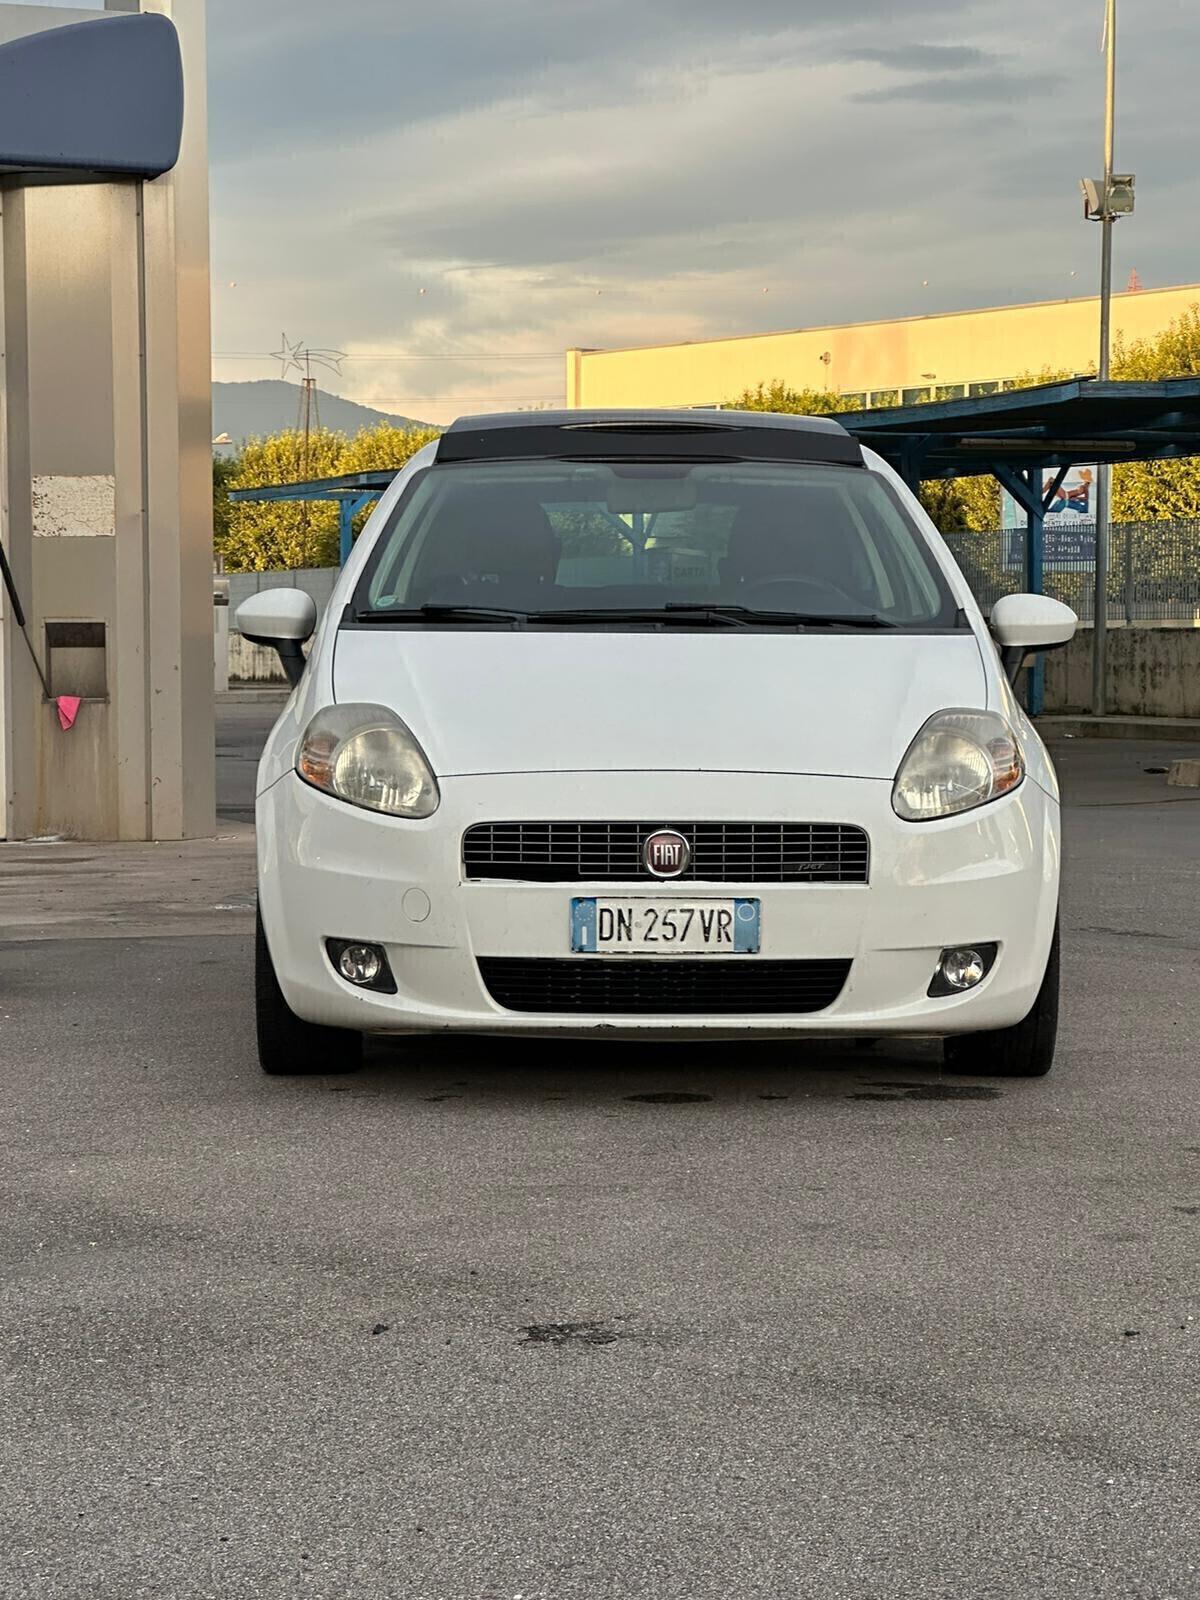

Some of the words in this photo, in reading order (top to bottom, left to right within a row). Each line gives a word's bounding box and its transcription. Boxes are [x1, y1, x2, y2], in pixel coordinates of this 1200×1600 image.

[653, 844, 681, 866] FIAT
[599, 908, 633, 942] DN
[643, 908, 733, 943] 257VR
